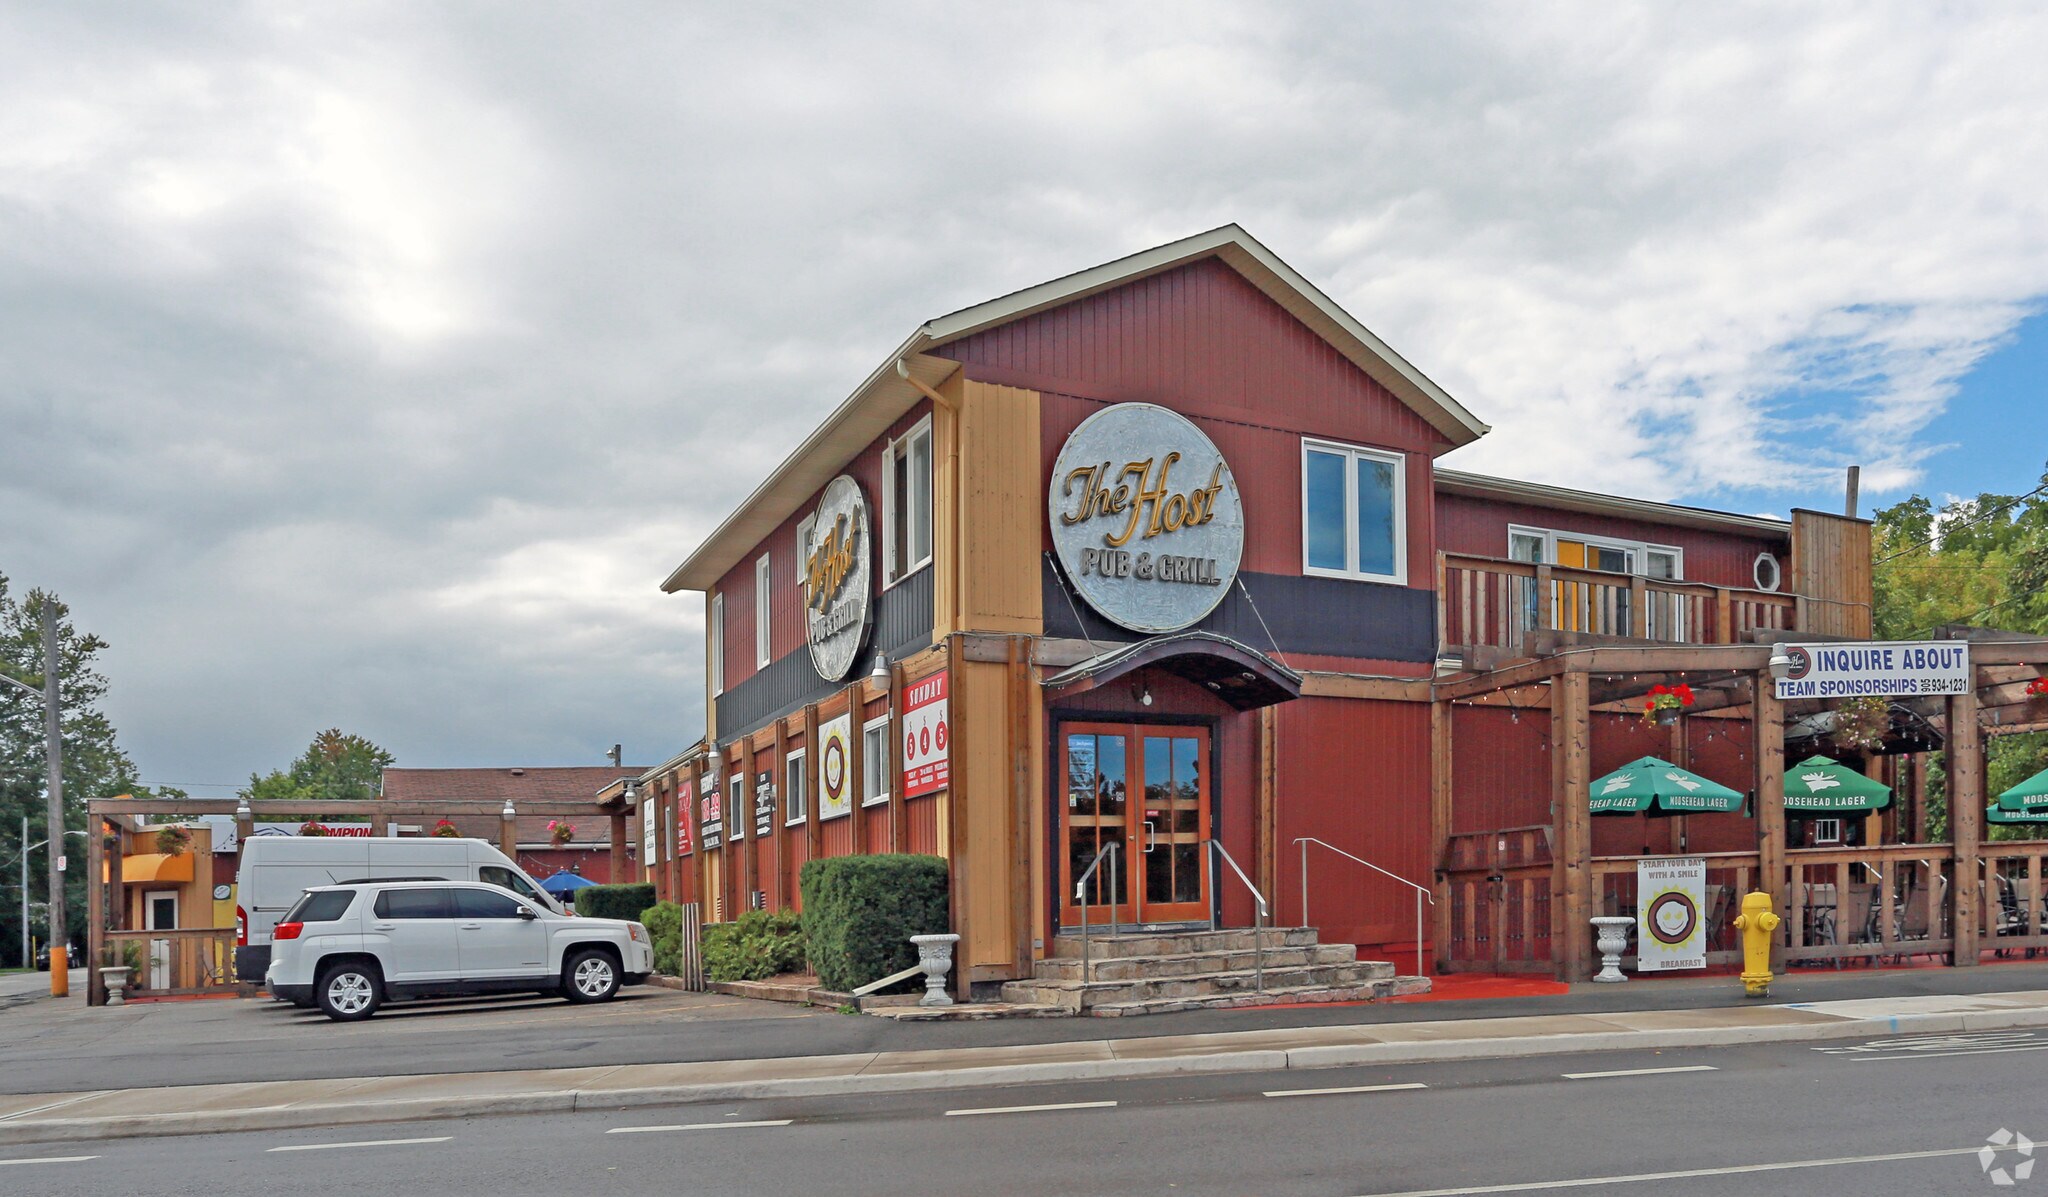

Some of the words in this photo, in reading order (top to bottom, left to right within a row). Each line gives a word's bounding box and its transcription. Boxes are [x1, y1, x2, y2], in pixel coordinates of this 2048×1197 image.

[1062, 461, 1129, 524] The
[1104, 451, 1223, 547] Host
[818, 504, 861, 615] Host
[1082, 548, 1131, 576] PUB
[1136, 552, 1153, 580] &
[1159, 554, 1222, 586] GRILL
[1817, 649, 1894, 672] INQUIRE
[1903, 647, 1963, 670] ABOUT
[909, 677, 942, 707] SUNDAY
[1779, 681, 1816, 697] TEAM
[1820, 678, 1918, 696] SPONSORSHIPS
[1920, 678, 1931, 693] 905
[1931, 678, 1967, 692] 934-1231
[1613, 797, 1638, 808] LAGER
[1669, 796, 1705, 807] MOOSEHEAD
[1707, 797, 1728, 808] LAGER
[1835, 796, 1866, 806] LAGER
[1643, 860, 1666, 869] START
[1667, 860, 1686, 868] YOUR
[1648, 871, 1668, 879] WITH
[1669, 871, 1676, 879] A
[1677, 870, 1698, 878] SMILE
[1660, 959, 1702, 969] BREAKFAST
